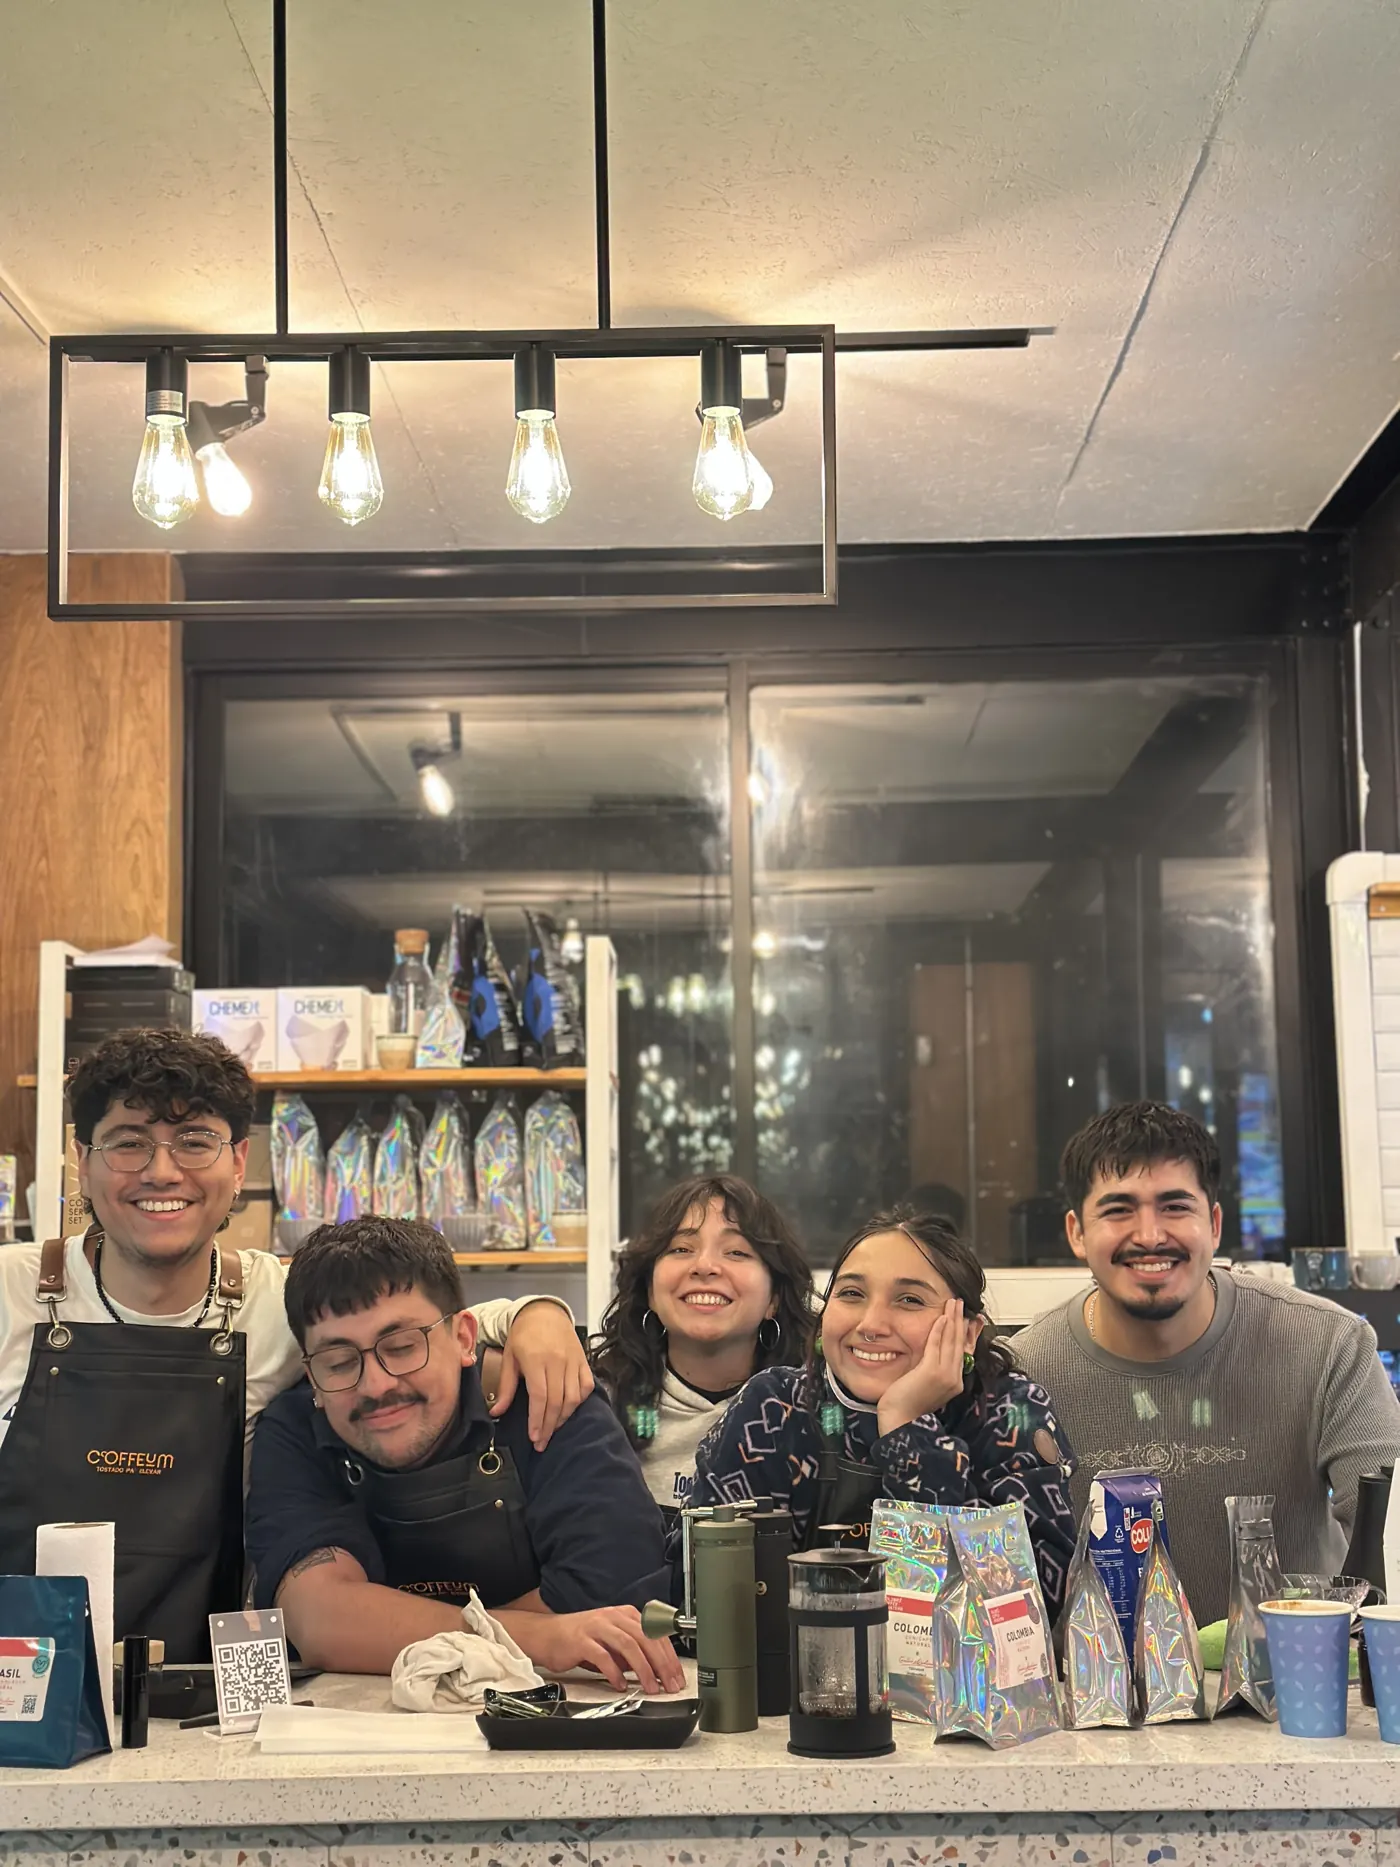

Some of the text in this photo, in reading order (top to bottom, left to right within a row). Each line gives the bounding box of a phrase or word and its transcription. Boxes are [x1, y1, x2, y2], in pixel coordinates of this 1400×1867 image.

[209, 1001, 260, 1015] CHEMEX
[294, 1000, 344, 1014] CHEMEX
[1006, 1626, 1035, 1643] COLOMBIA
